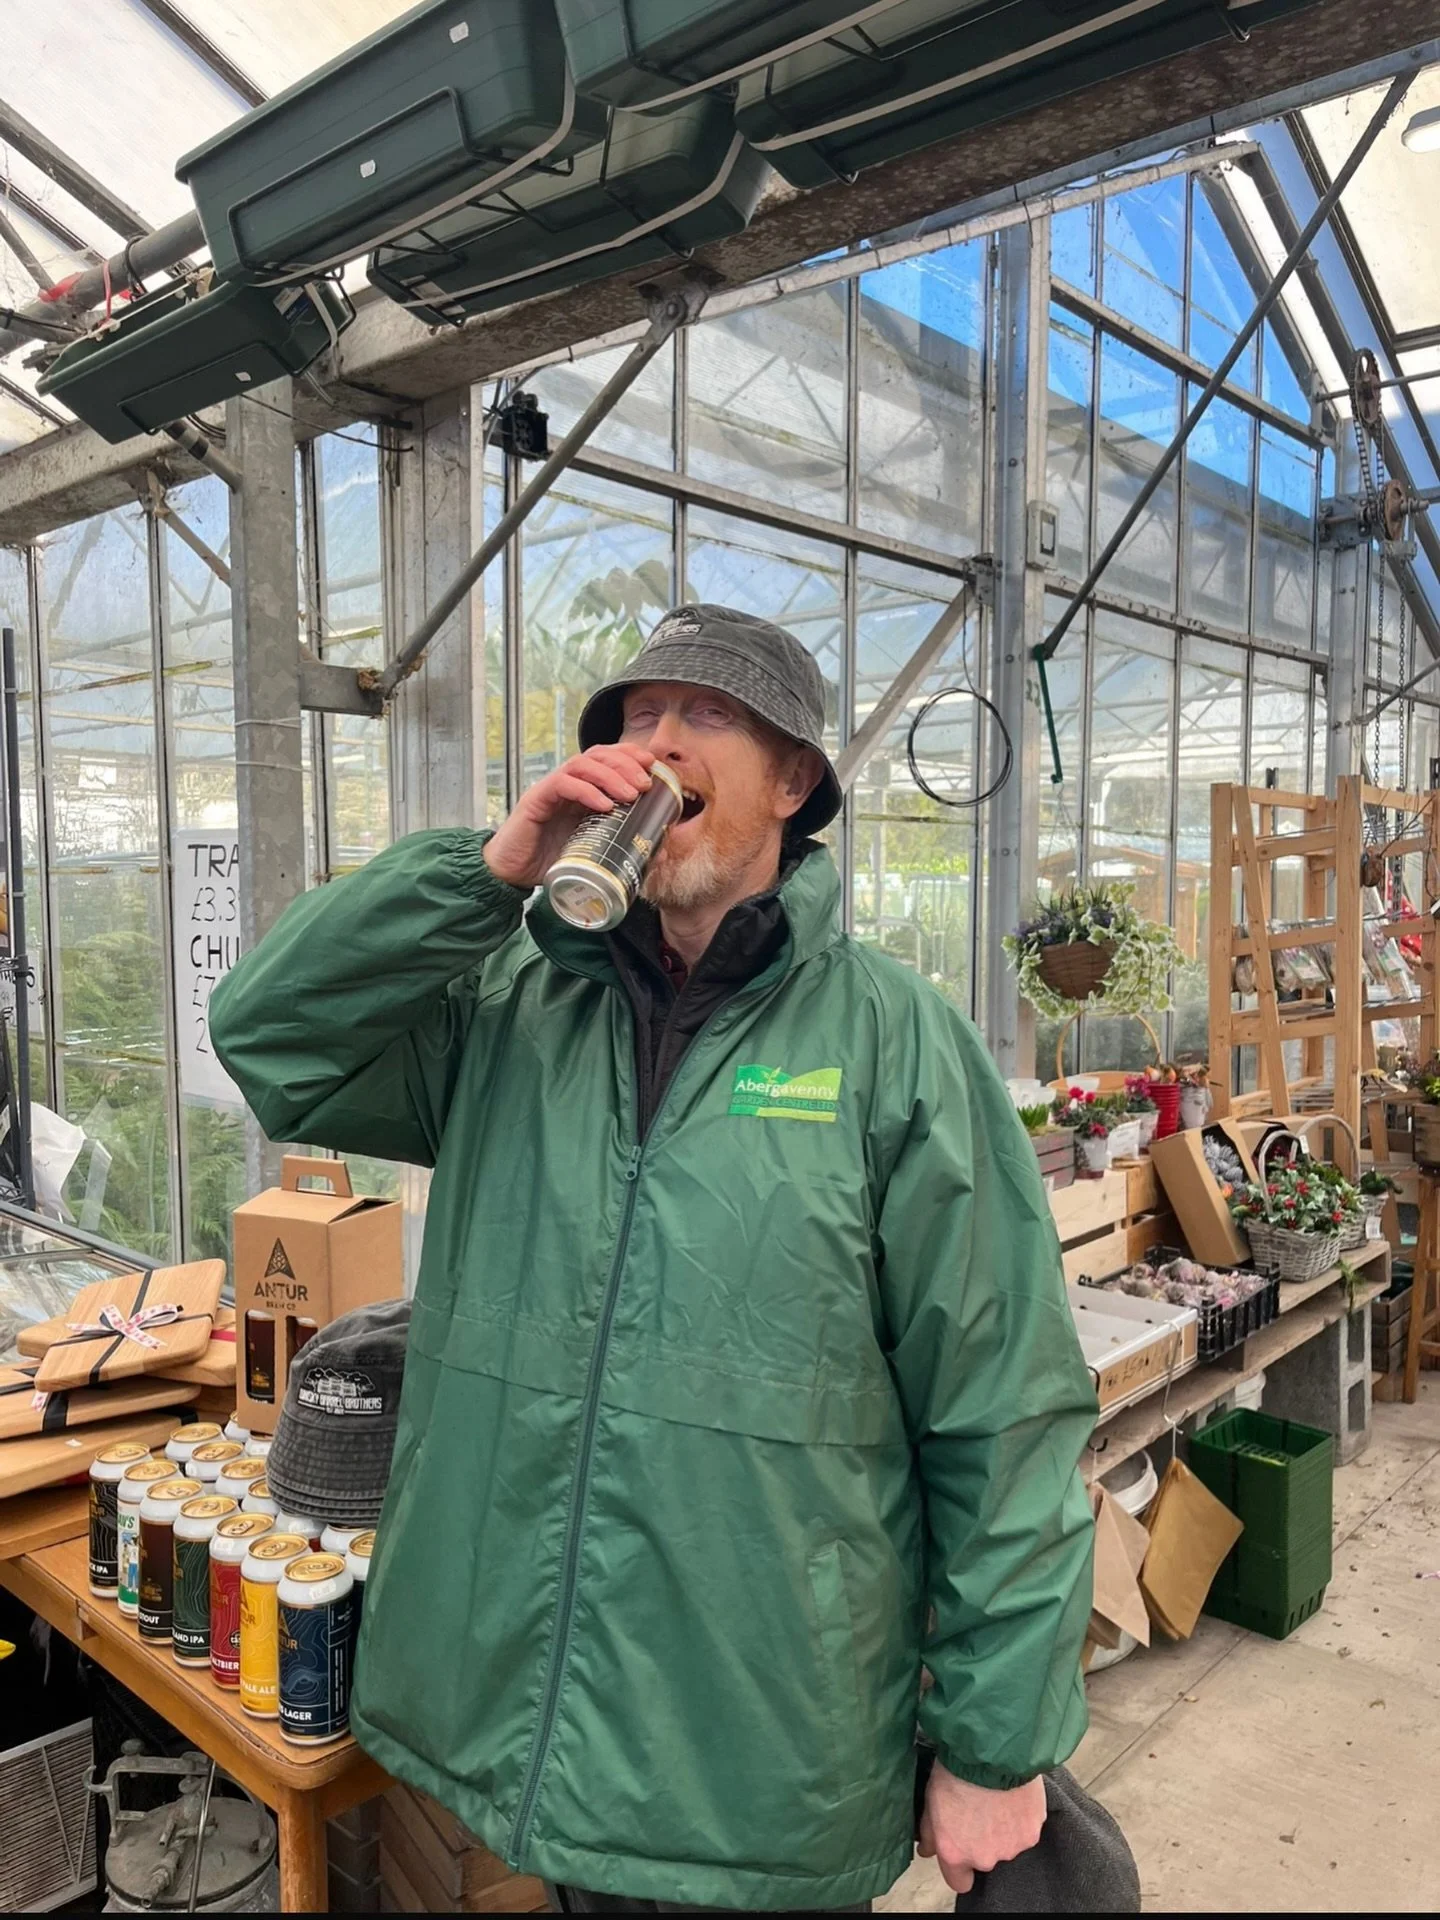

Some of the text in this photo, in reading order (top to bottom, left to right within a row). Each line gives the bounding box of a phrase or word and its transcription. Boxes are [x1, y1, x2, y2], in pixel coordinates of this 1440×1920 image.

[190, 934, 240, 970] CHU
[734, 1078, 838, 1099] Abergavenny
[254, 1280, 308, 1301] ANTUR
[190, 1634, 205, 1644] IPA
[260, 1685, 276, 1694] ALE
[284, 1708, 312, 1721] LAGER
